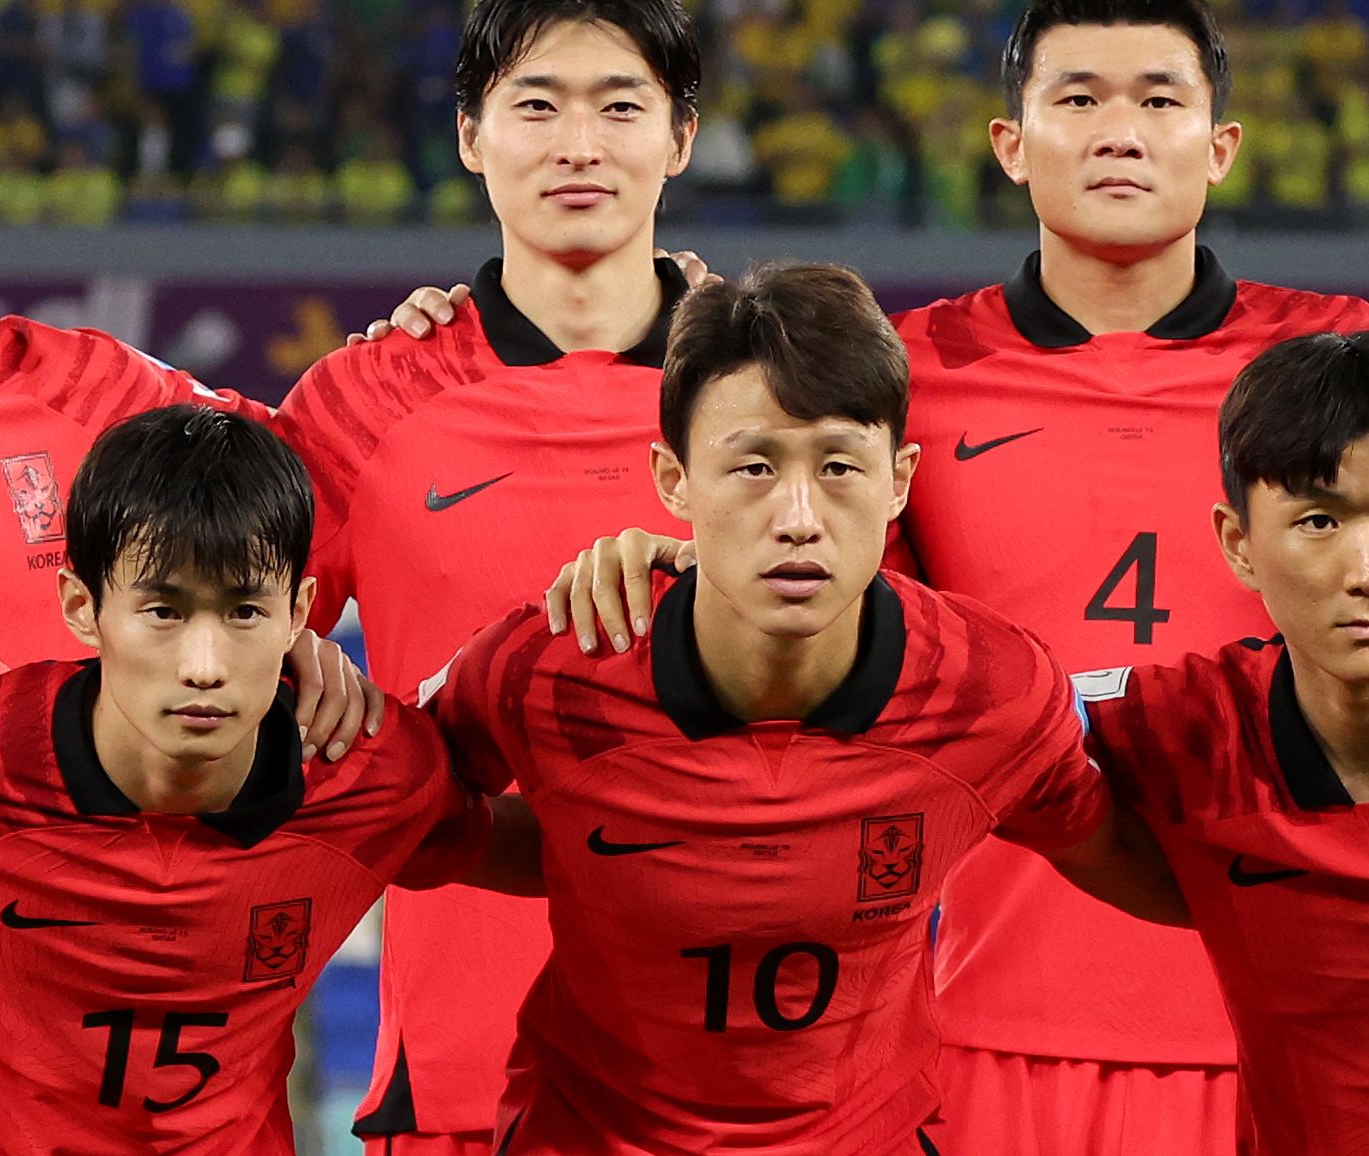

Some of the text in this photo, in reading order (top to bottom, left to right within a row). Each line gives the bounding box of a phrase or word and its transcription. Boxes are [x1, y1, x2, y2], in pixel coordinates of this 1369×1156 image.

[1084, 531, 1171, 645] 4
[852, 901, 911, 923] KOREA
[680, 942, 840, 1032] 10
[82, 1008, 229, 1114] 15
